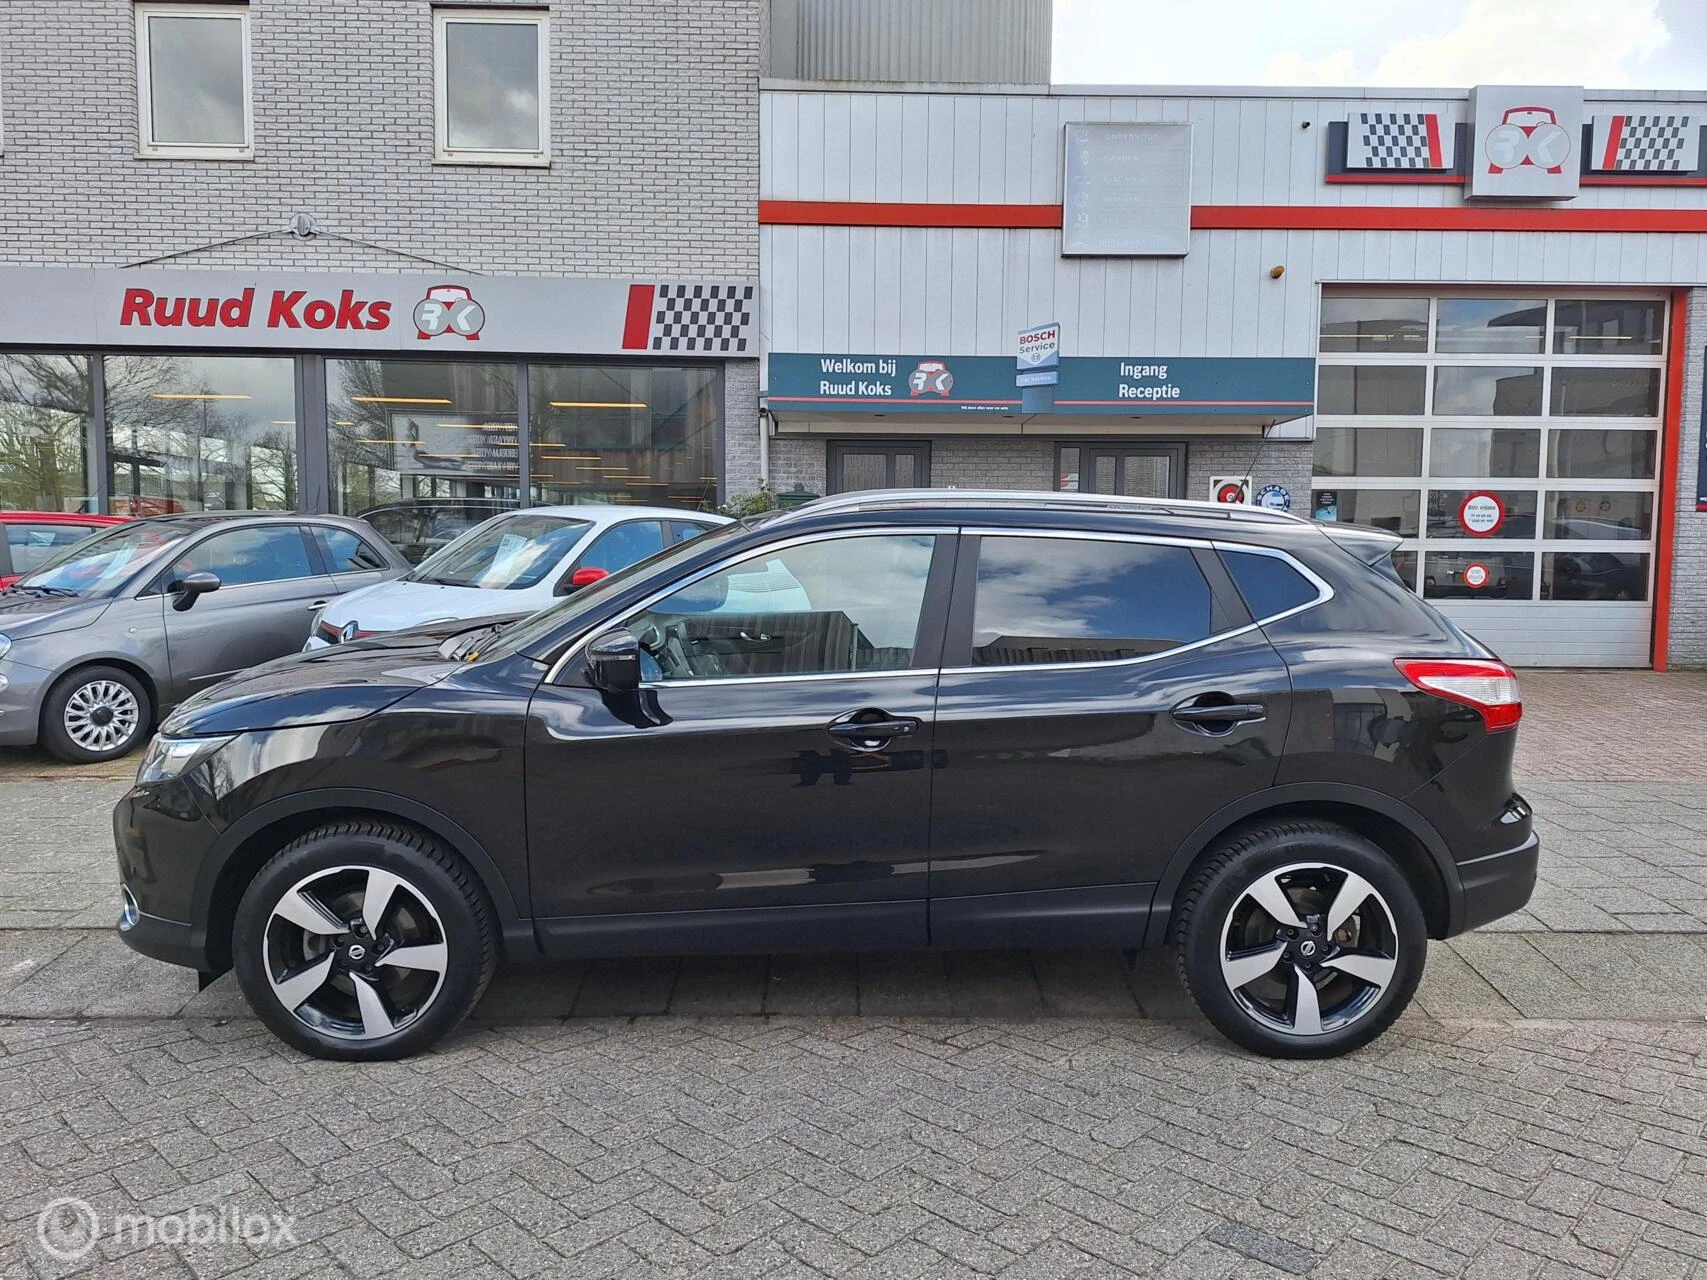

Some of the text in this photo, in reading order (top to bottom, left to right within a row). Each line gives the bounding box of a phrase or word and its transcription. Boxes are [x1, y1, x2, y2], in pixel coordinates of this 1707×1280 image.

[119, 287, 392, 331] Ruud Koks
[1019, 329, 1056, 345] BOSCH
[1018, 340, 1056, 354] Service
[820, 358, 897, 377] Welkom bij
[1120, 361, 1169, 380] Ingang
[819, 380, 892, 396] Ruud Koks
[1118, 383, 1181, 401] Receptie
[1256, 485, 1290, 502] SCHADE
